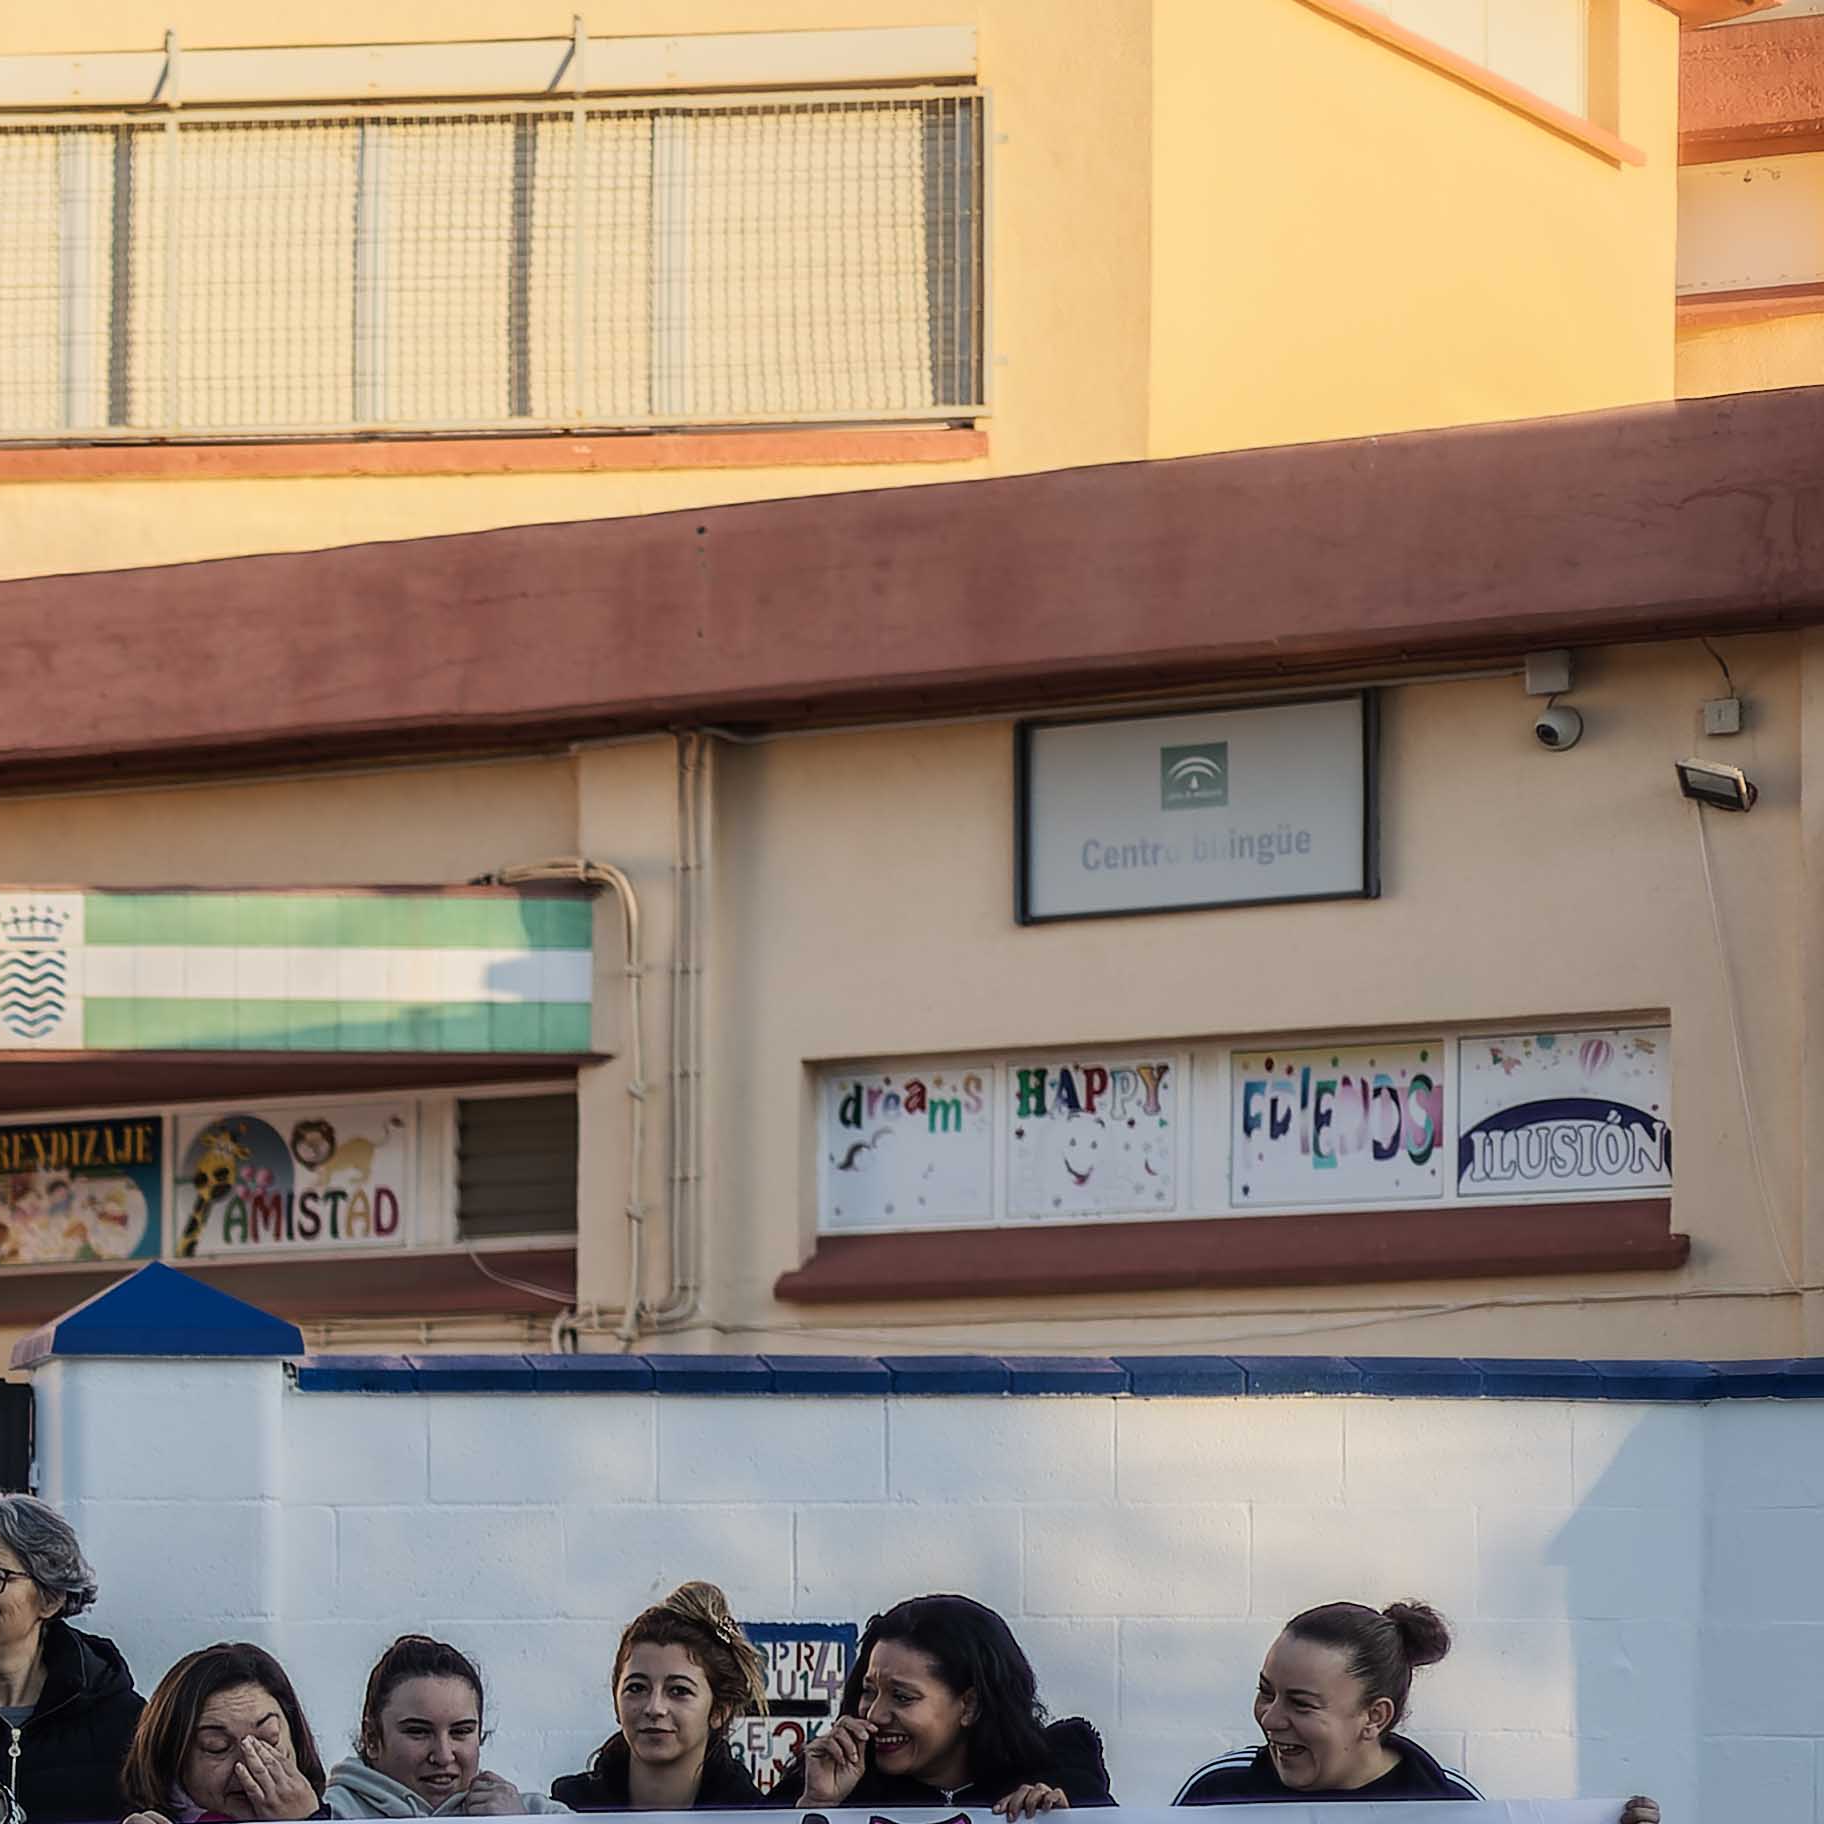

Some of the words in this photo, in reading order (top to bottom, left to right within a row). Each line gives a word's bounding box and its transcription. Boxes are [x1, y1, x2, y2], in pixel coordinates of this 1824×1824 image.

[838, 1072, 984, 1134] dreams
[1015, 1062, 1170, 1119] HAPPY
[1467, 1108, 1668, 1183] ILUSIÓN
[223, 1185, 400, 1244] AMISTAD
